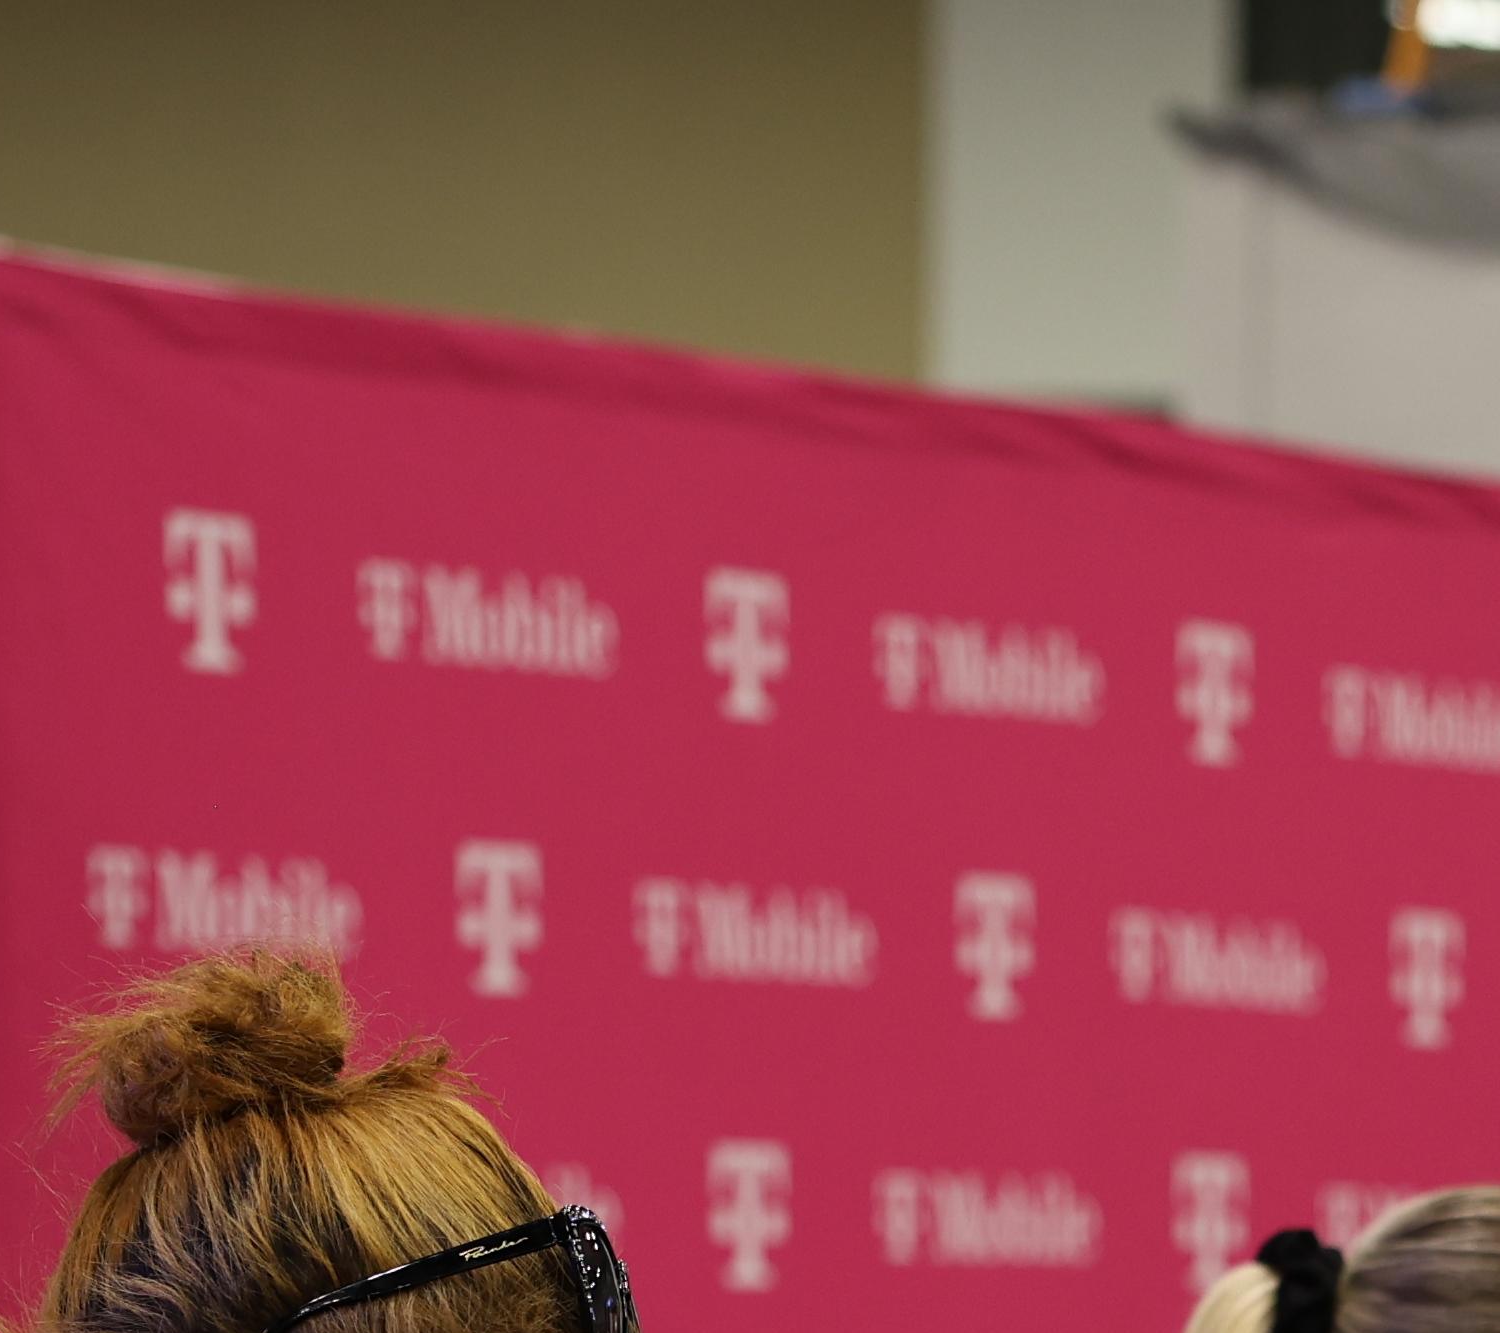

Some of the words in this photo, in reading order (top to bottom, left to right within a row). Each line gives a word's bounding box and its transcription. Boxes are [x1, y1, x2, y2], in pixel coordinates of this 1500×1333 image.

[419, 562, 619, 680] Mobile
[927, 617, 1105, 726] Mobile
[694, 880, 878, 988] Mobile
[927, 1170, 1103, 1266] Mobile
